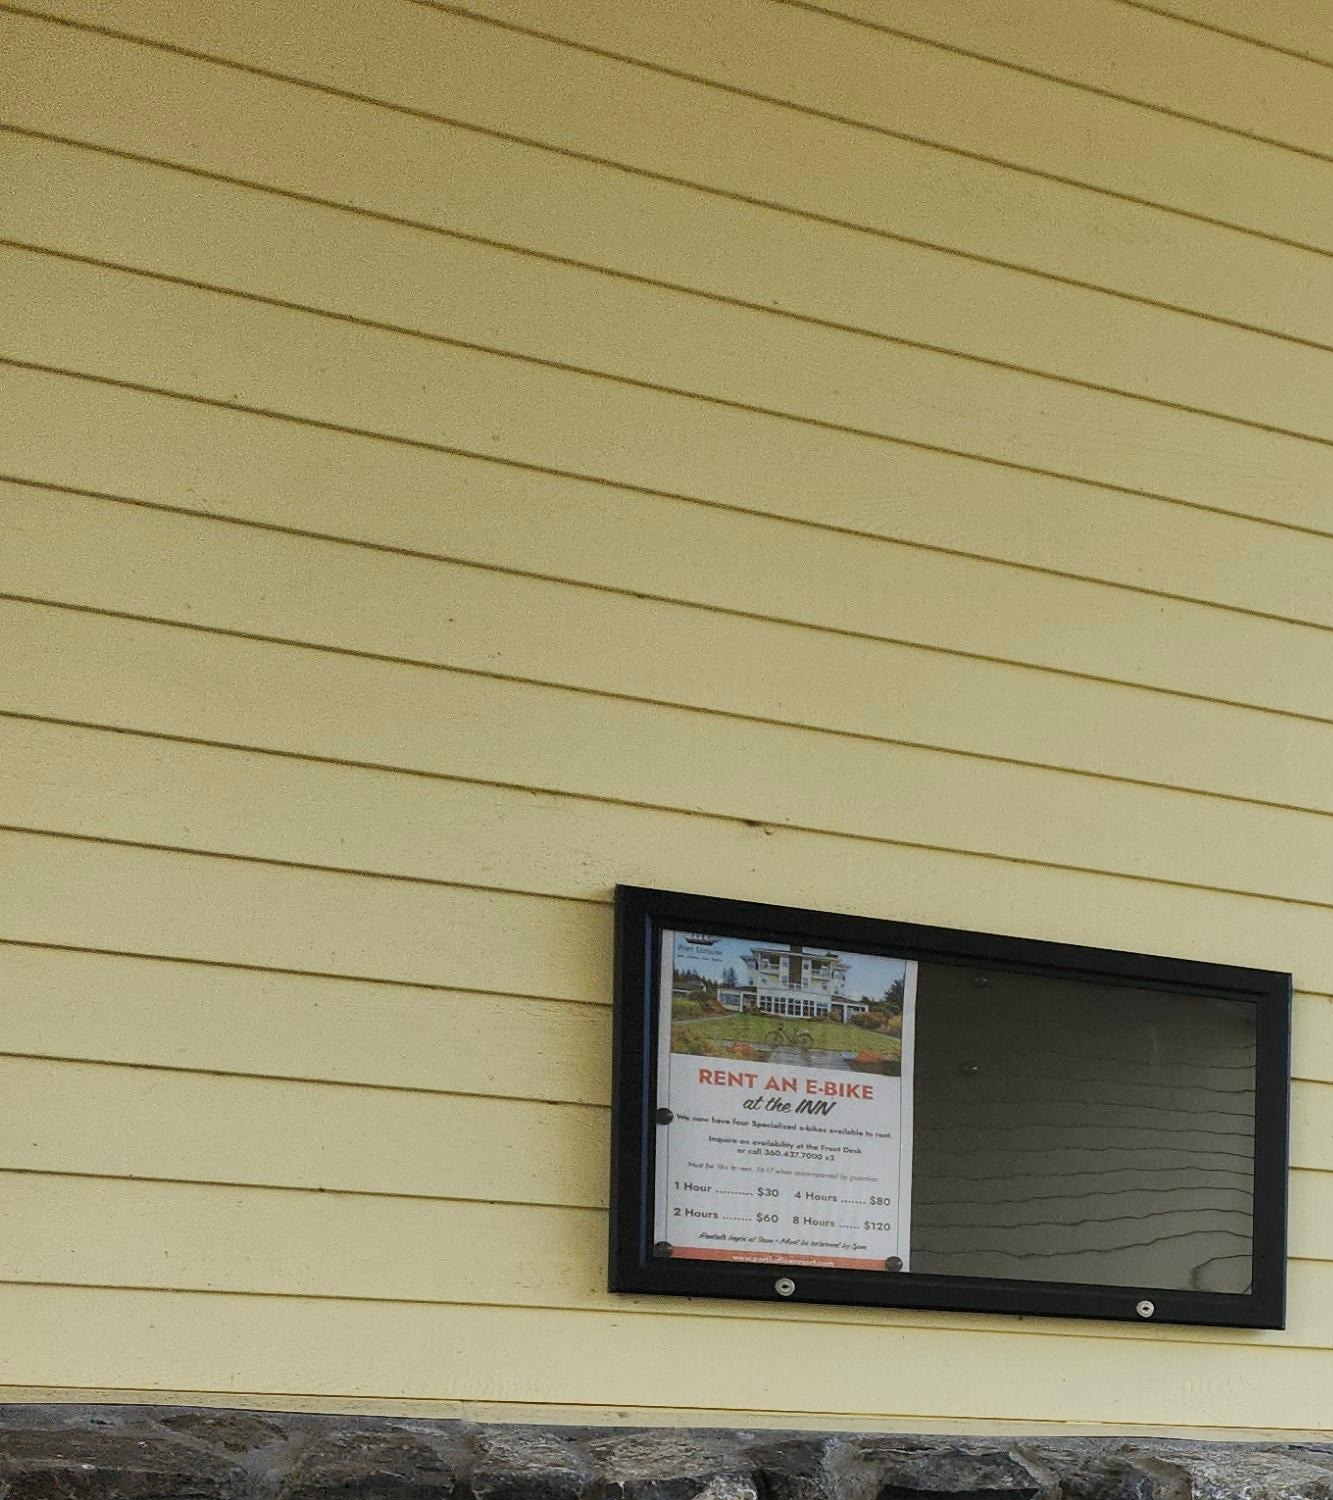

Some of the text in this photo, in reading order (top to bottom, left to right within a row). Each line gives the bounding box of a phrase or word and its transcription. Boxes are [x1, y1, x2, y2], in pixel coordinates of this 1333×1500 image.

[698, 1069, 874, 1100] RENT AN E-BIKE
[743, 1095, 836, 1117] at the INN
[676, 1113, 690, 1122] We
[712, 1115, 730, 1125] have
[732, 1118, 749, 1127] four
[752, 1120, 797, 1131] Specialized
[799, 1124, 827, 1134] e-bikes
[829, 1127, 863, 1137] available
[748, 1147, 762, 1156] call
[752, 1138, 794, 1150] availability
[806, 1143, 819, 1151] the
[820, 1144, 841, 1153] Front
[843, 1146, 862, 1155] Desk
[684, 1181, 712, 1193] Hour
[757, 1186, 779, 1198] $30
[794, 1190, 891, 1207] 4 Hours $80
[673, 1207, 779, 1224] 2 Hours $60
[793, 1215, 891, 1232] 8 Hours $120
